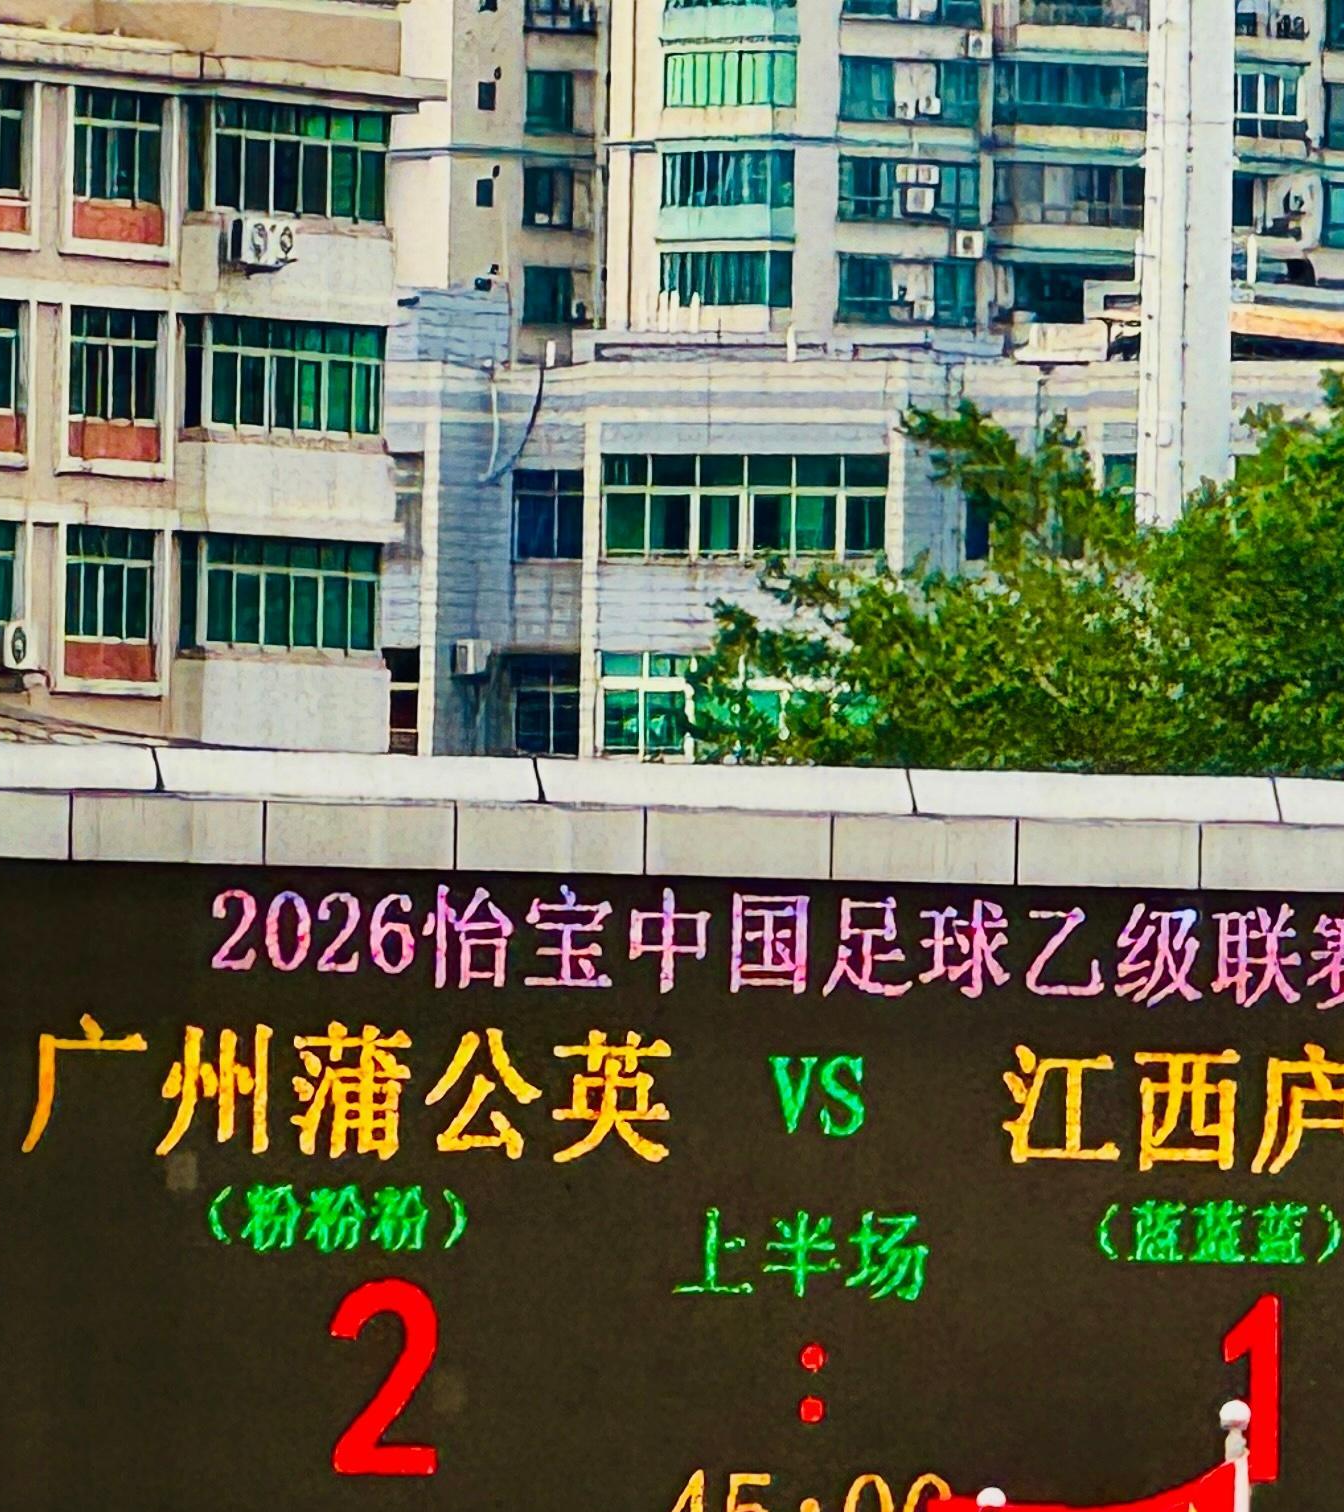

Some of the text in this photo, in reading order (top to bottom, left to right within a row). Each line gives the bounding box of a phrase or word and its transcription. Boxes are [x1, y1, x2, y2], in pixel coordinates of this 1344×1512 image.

[21, 1013, 672, 1163] 广州蒲公英
[768, 1055, 865, 1137] VS
[672, 1207, 930, 1301] 上半场
[329, 1278, 439, 1477] 2
[1223, 1294, 1281, 1484] 1
